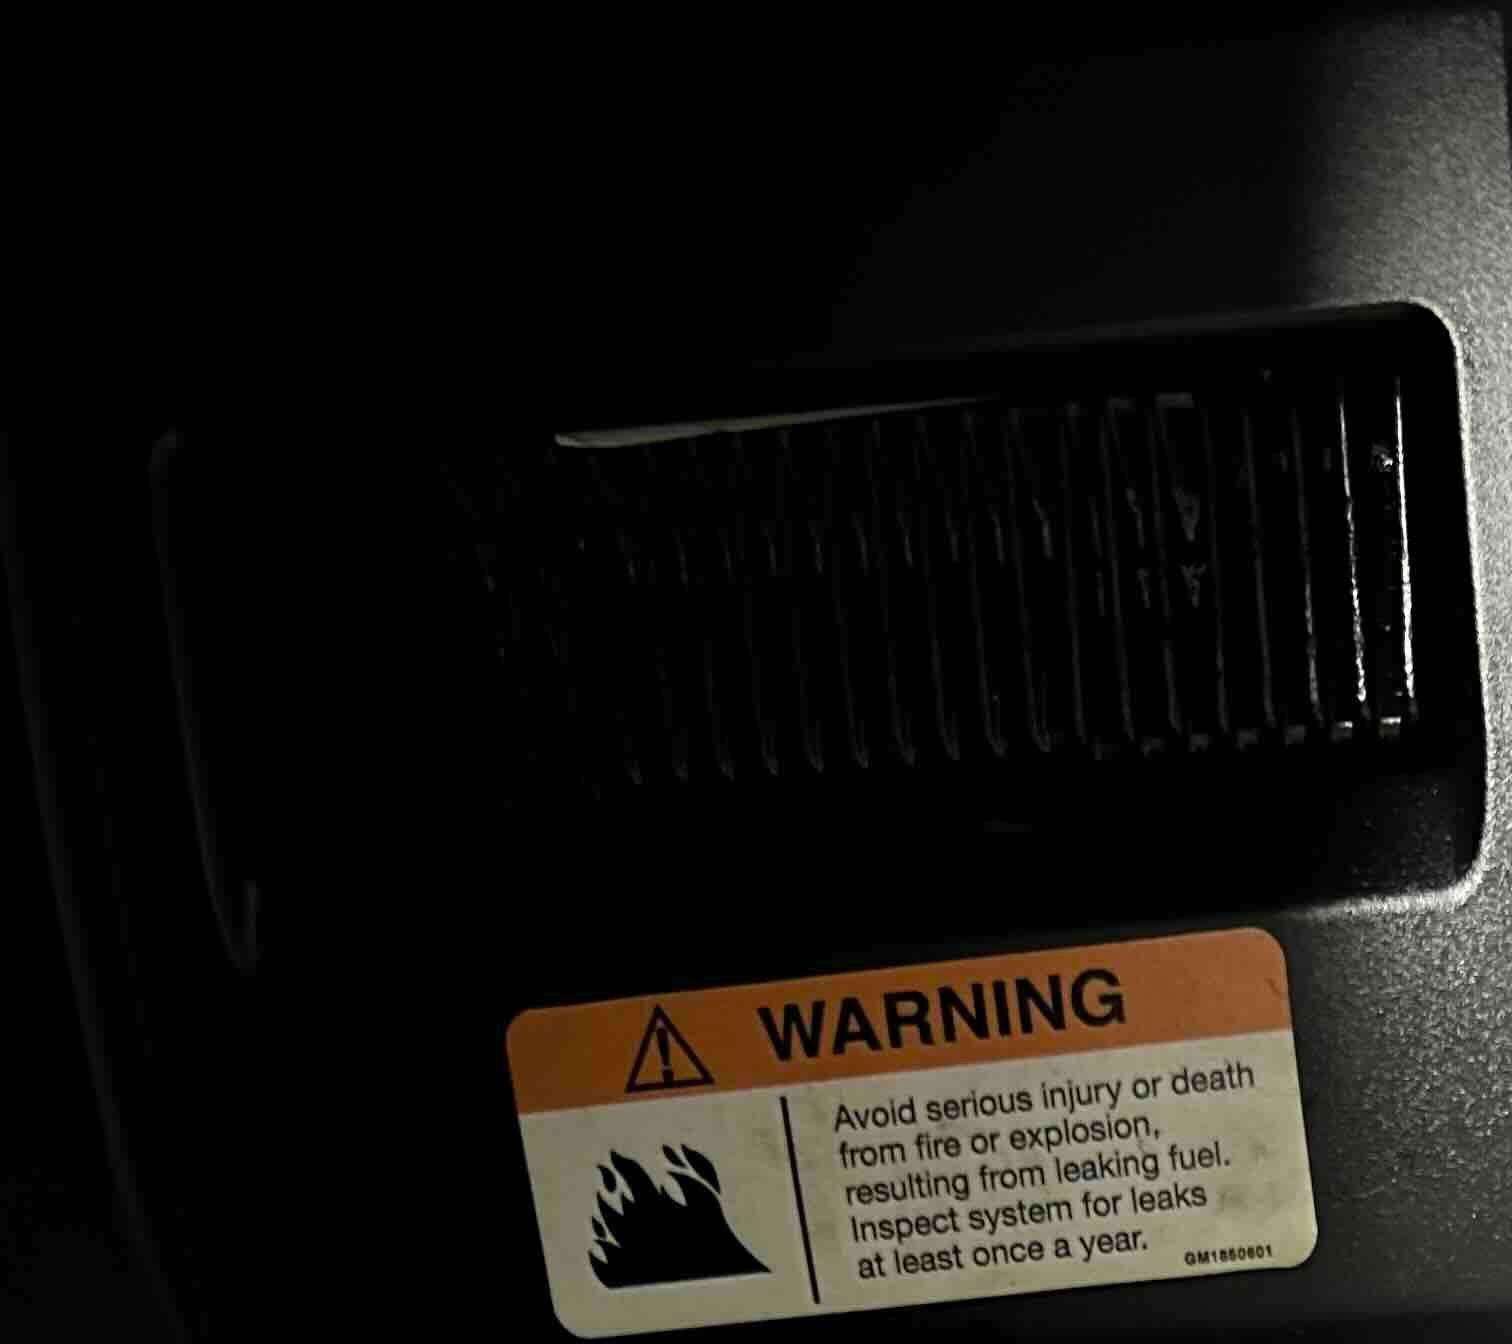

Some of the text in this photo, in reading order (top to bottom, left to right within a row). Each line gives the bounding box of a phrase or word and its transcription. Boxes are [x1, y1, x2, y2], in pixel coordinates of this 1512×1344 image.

[757, 968, 1127, 1063] WARNING
[834, 1060, 1255, 1134] Avoid serious injury or death
[839, 1113, 1160, 1169] from fire or explosion,
[845, 1140, 1231, 1206] resulting from leaking fuel.
[851, 1182, 1207, 1244] Inspect system for leaks
[858, 1230, 1149, 1279] at least once a year.
